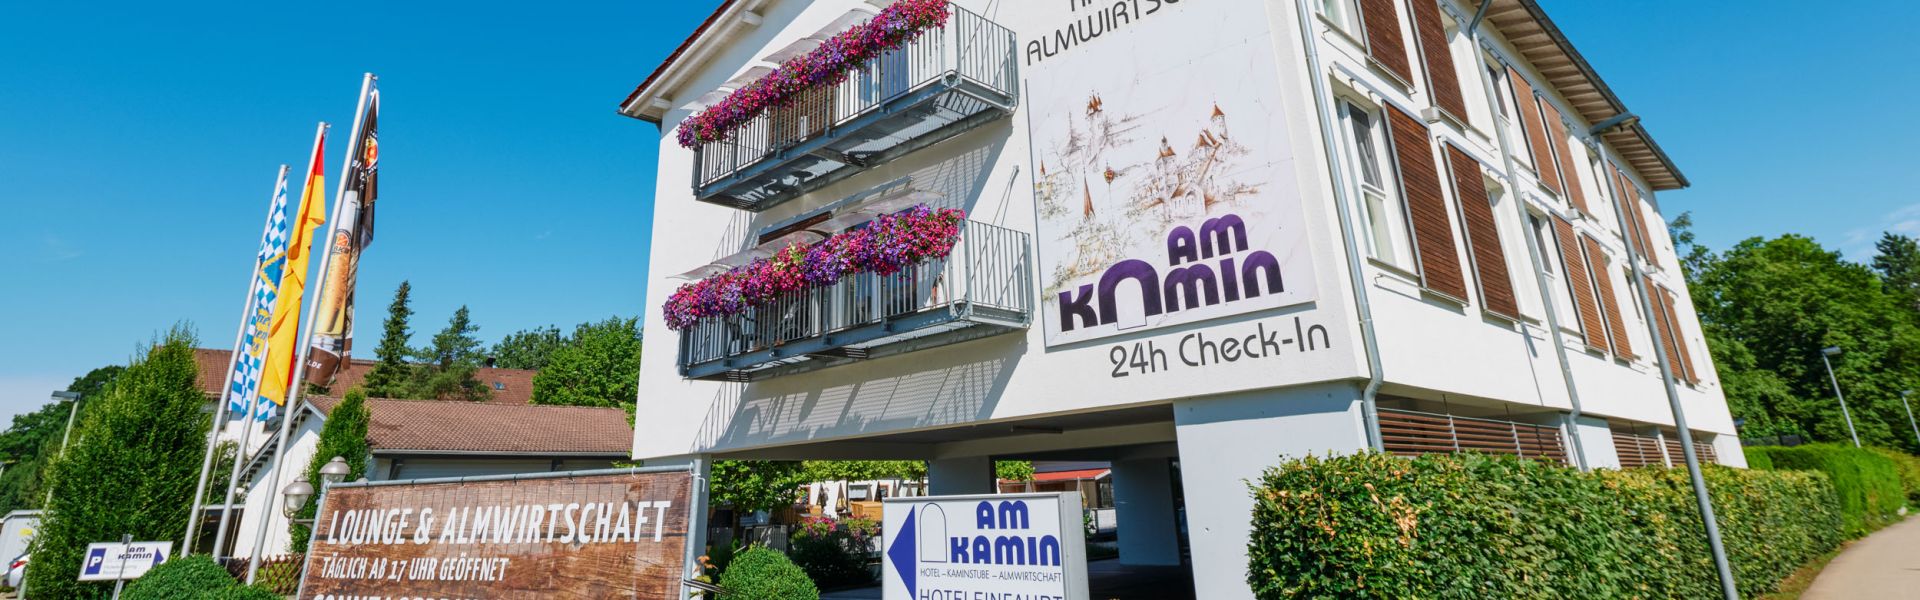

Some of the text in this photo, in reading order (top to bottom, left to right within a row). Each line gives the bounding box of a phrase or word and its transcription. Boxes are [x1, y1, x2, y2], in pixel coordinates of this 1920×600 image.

[1027, 0, 1179, 66] ALMWIRTS
[1167, 213, 1248, 266] AM
[1110, 316, 1331, 378] 24h Check-In
[327, 501, 671, 545] LOUNGE & ALMWIRTSCHAFT
[976, 500, 1030, 529] AM
[322, 552, 510, 583] TÄGLICH AB 17 UHR GEÖFFNET
[950, 535, 1061, 566] KAMIN
[920, 568, 941, 578] HOTEL
[947, 569, 990, 579] KAMINSTUBE
[998, 571, 1062, 582] ALMWIRTSCHAFT
